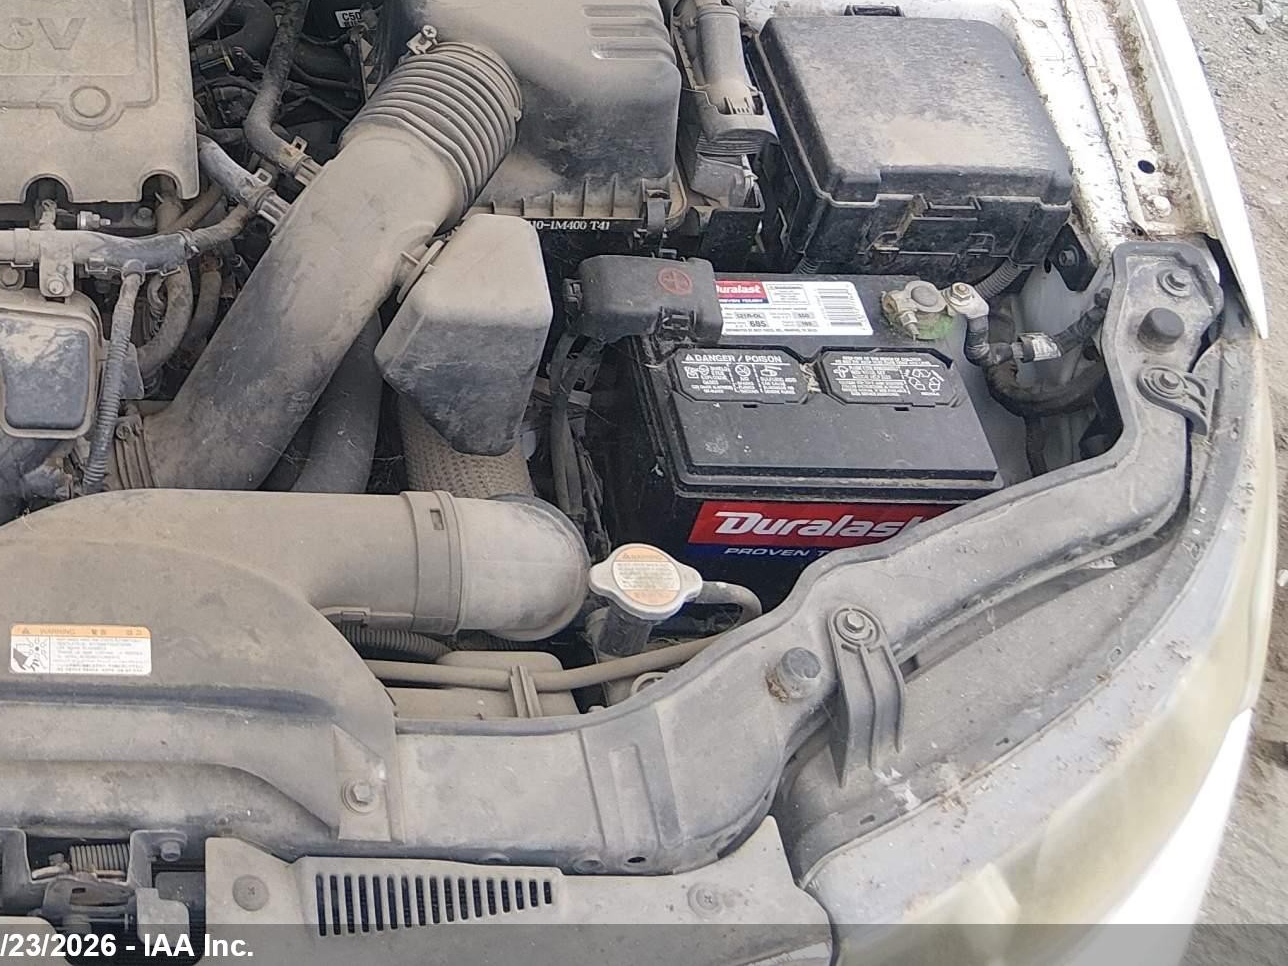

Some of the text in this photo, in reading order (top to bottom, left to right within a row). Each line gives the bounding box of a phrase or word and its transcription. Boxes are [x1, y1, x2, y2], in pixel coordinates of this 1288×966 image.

[715, 284, 761, 294] uralast
[694, 354, 736, 363] DANGER
[745, 354, 783, 363] POISON
[723, 547, 811, 557] PROVEN
